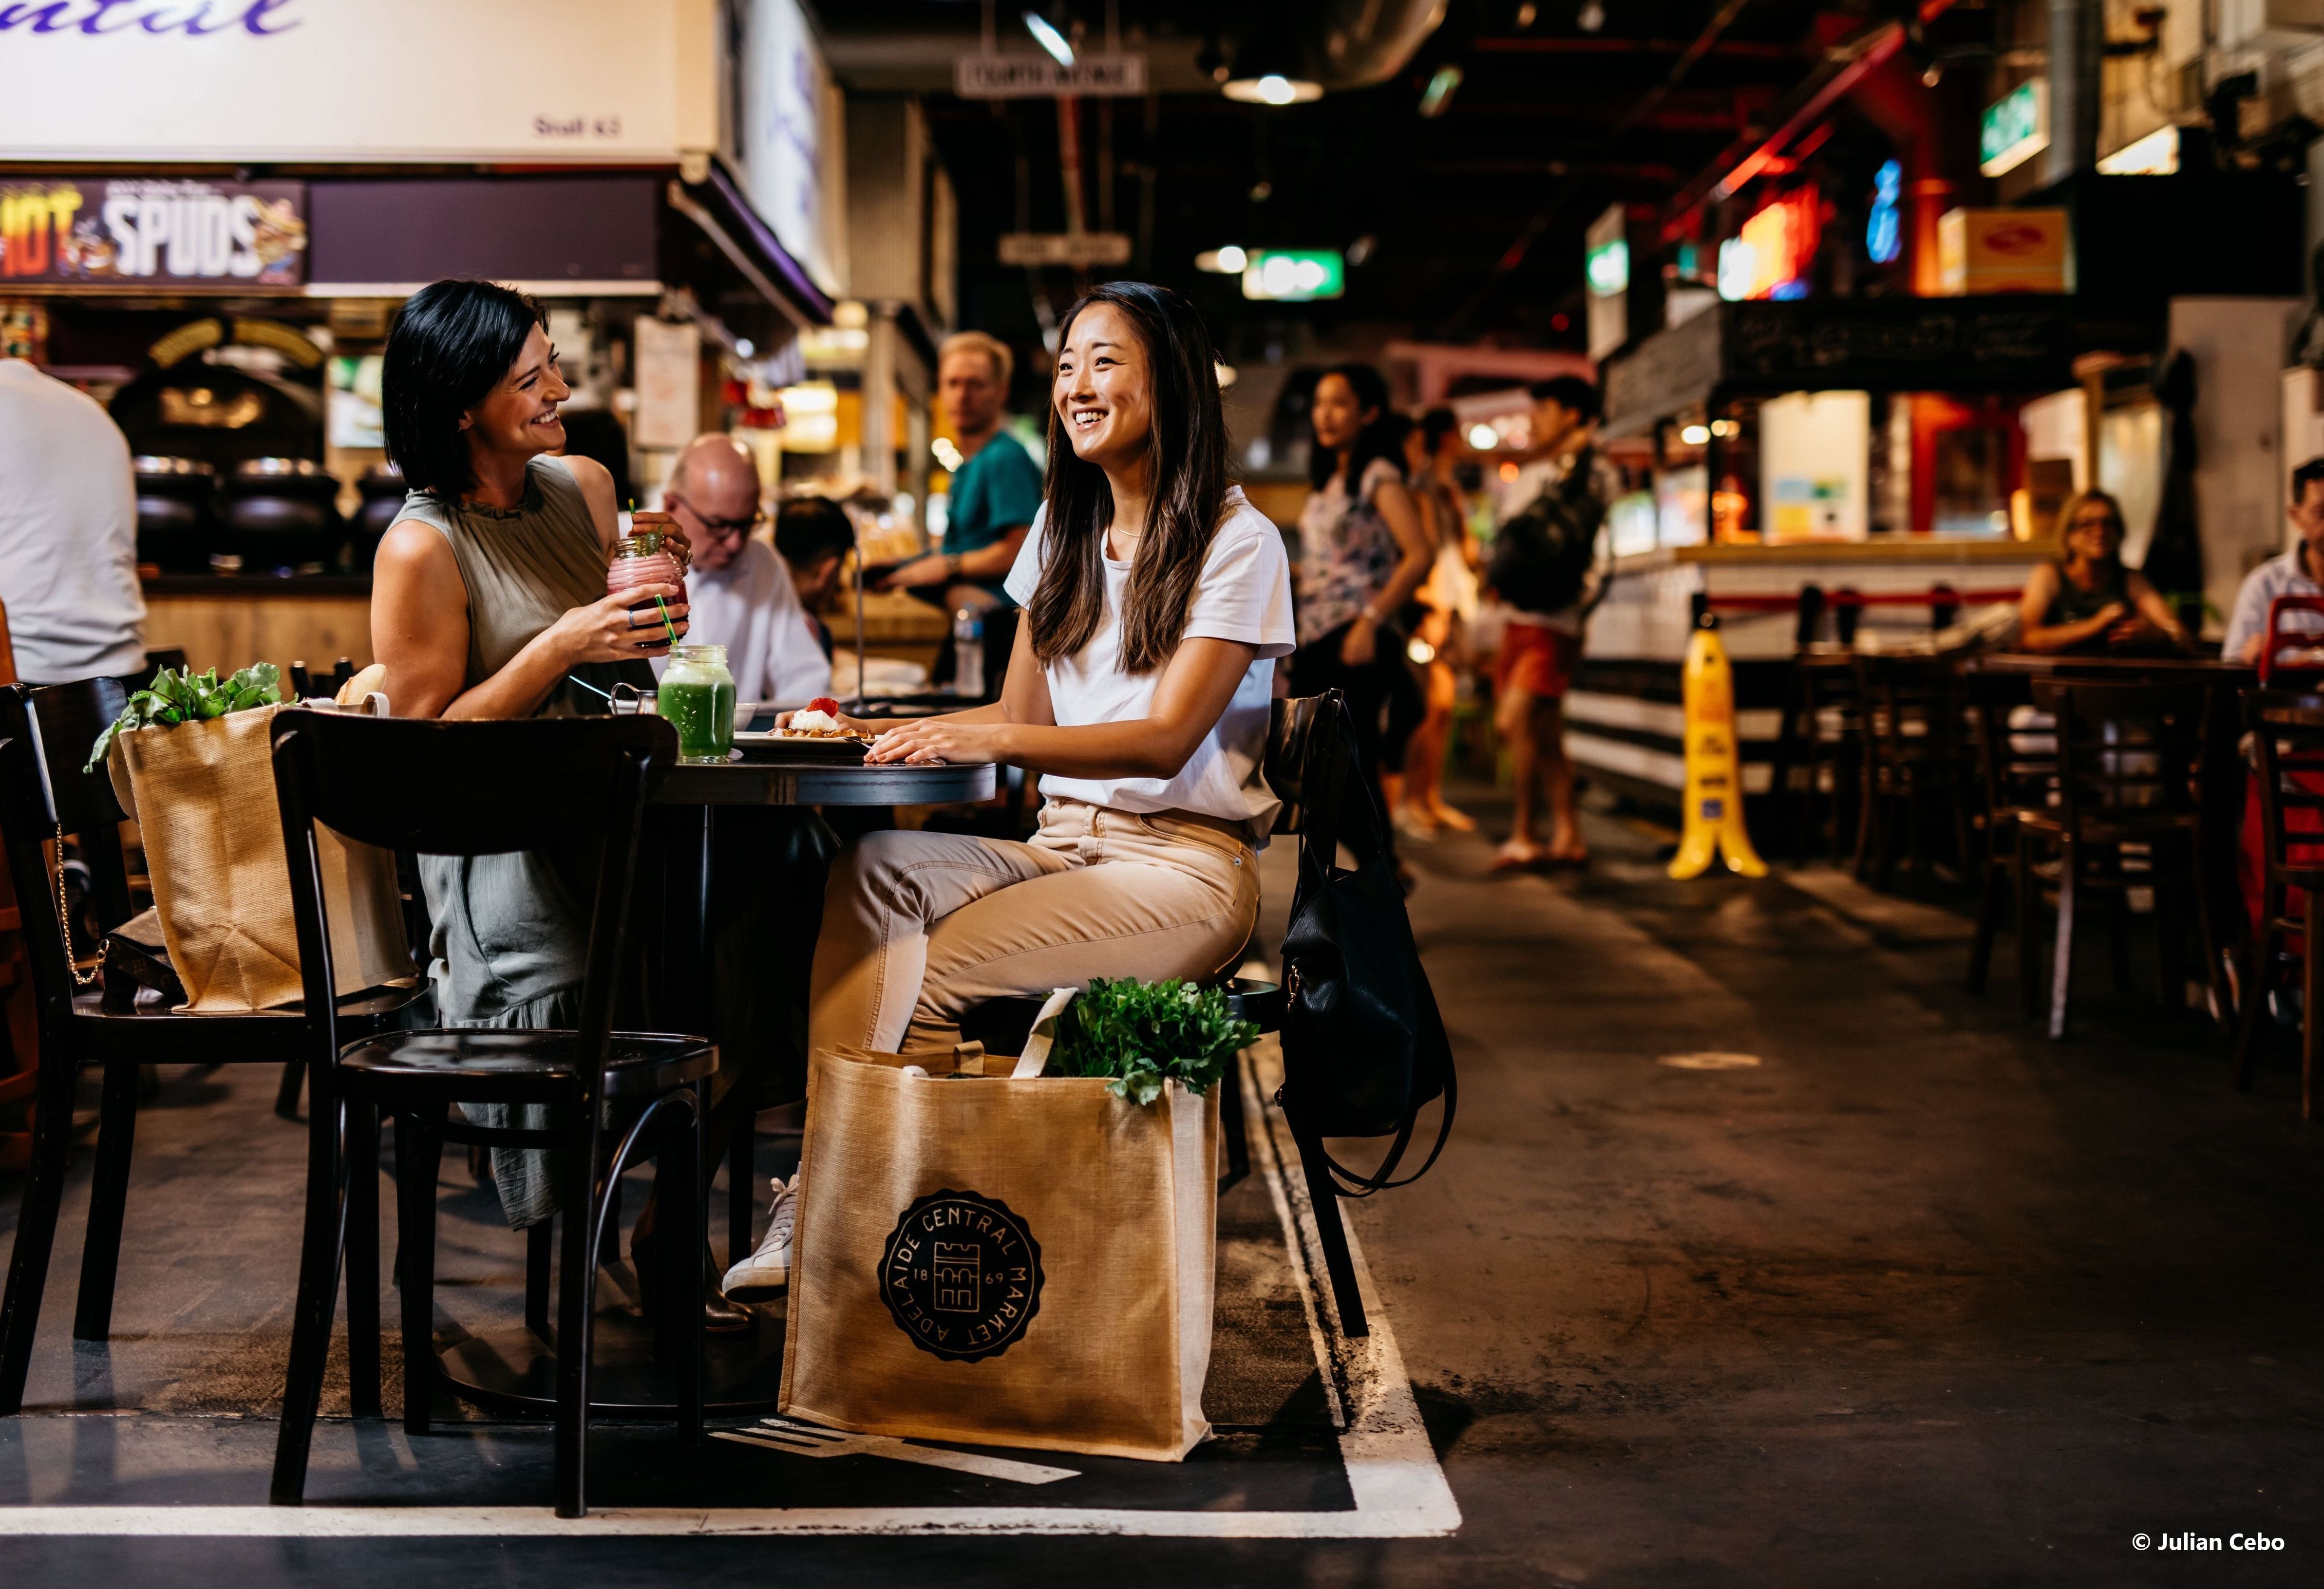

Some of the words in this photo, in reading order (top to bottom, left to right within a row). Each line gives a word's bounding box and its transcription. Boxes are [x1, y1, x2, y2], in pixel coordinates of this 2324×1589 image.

[104, 193, 265, 279] SPUDS
[923, 1207, 1017, 1255] CENTRAL
[893, 1233, 949, 1342] ADELAIDE
[914, 1268, 928, 1281] 18
[985, 1272, 1003, 1285] 69
[968, 1267, 1026, 1345] MARKET
